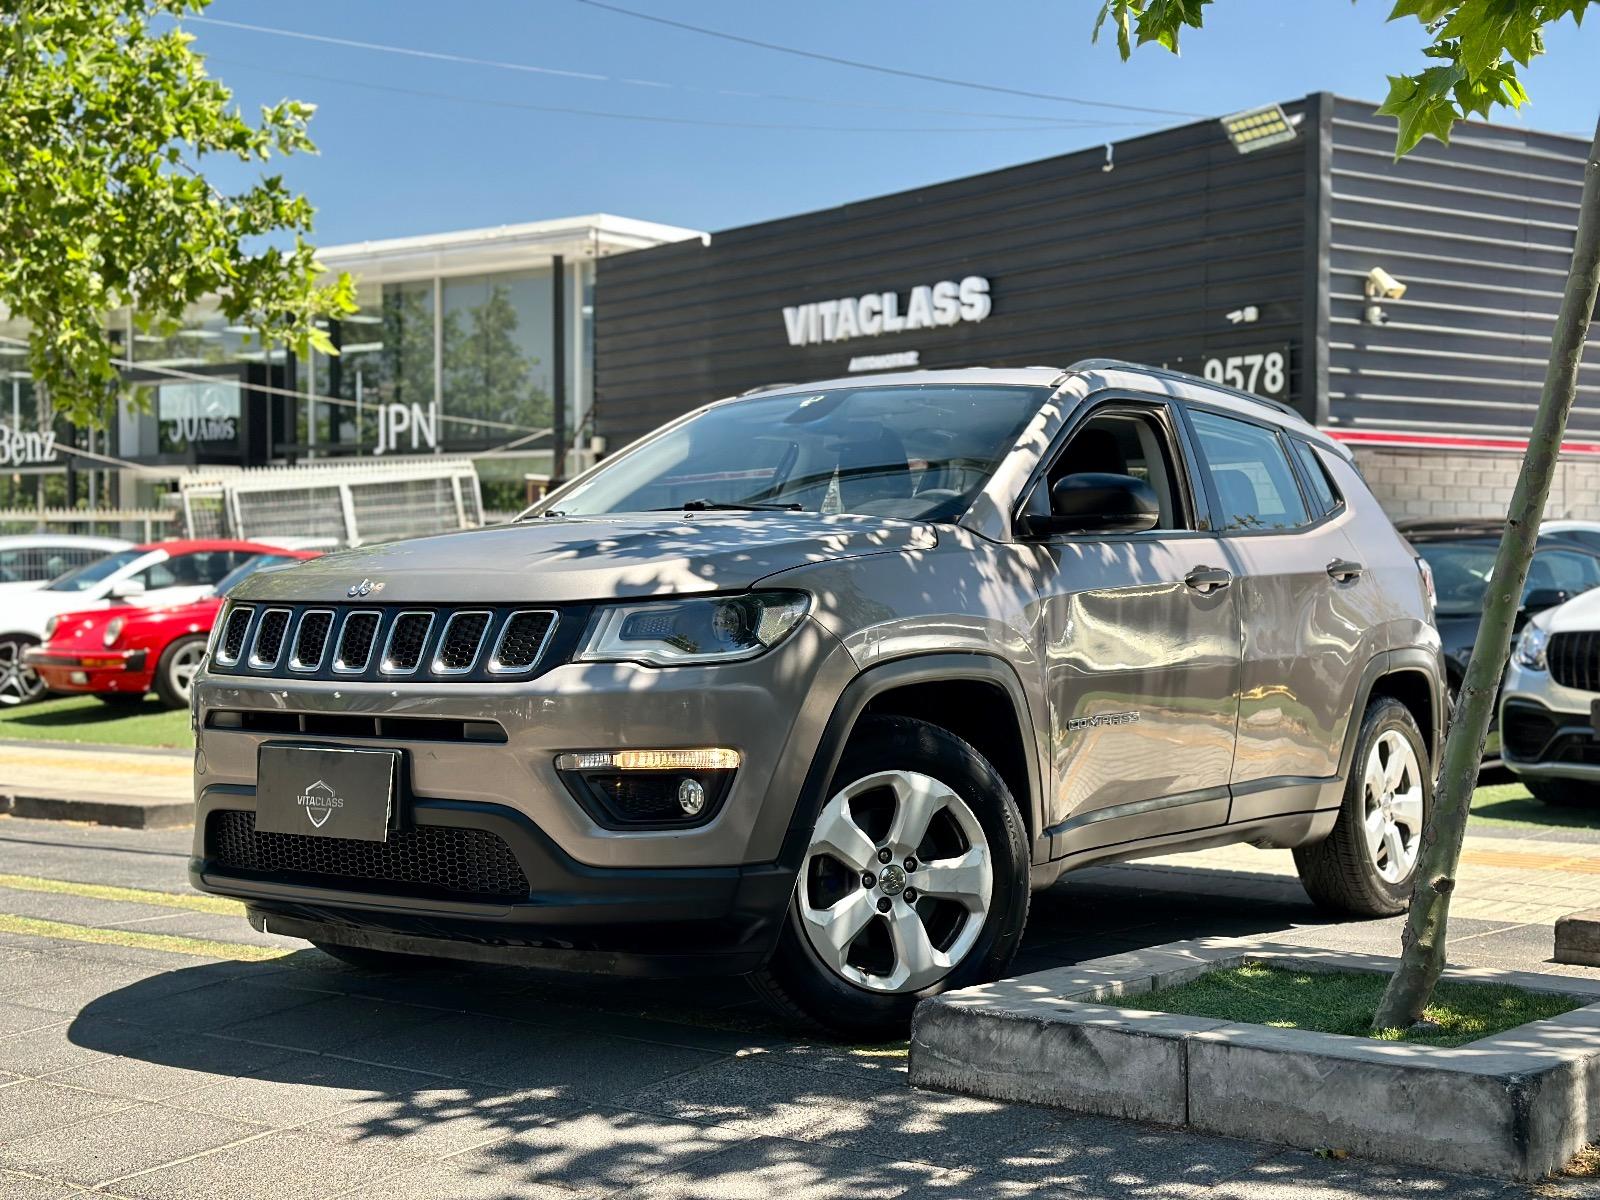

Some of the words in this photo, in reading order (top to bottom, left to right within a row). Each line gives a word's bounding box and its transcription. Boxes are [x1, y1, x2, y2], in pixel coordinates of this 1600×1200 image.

[782, 276, 992, 346] VITACLASS
[1204, 352, 1285, 394] 9578
[0, 424, 57, 466] Benz
[373, 401, 436, 456] JPN
[297, 795, 344, 808] VITACLASS
